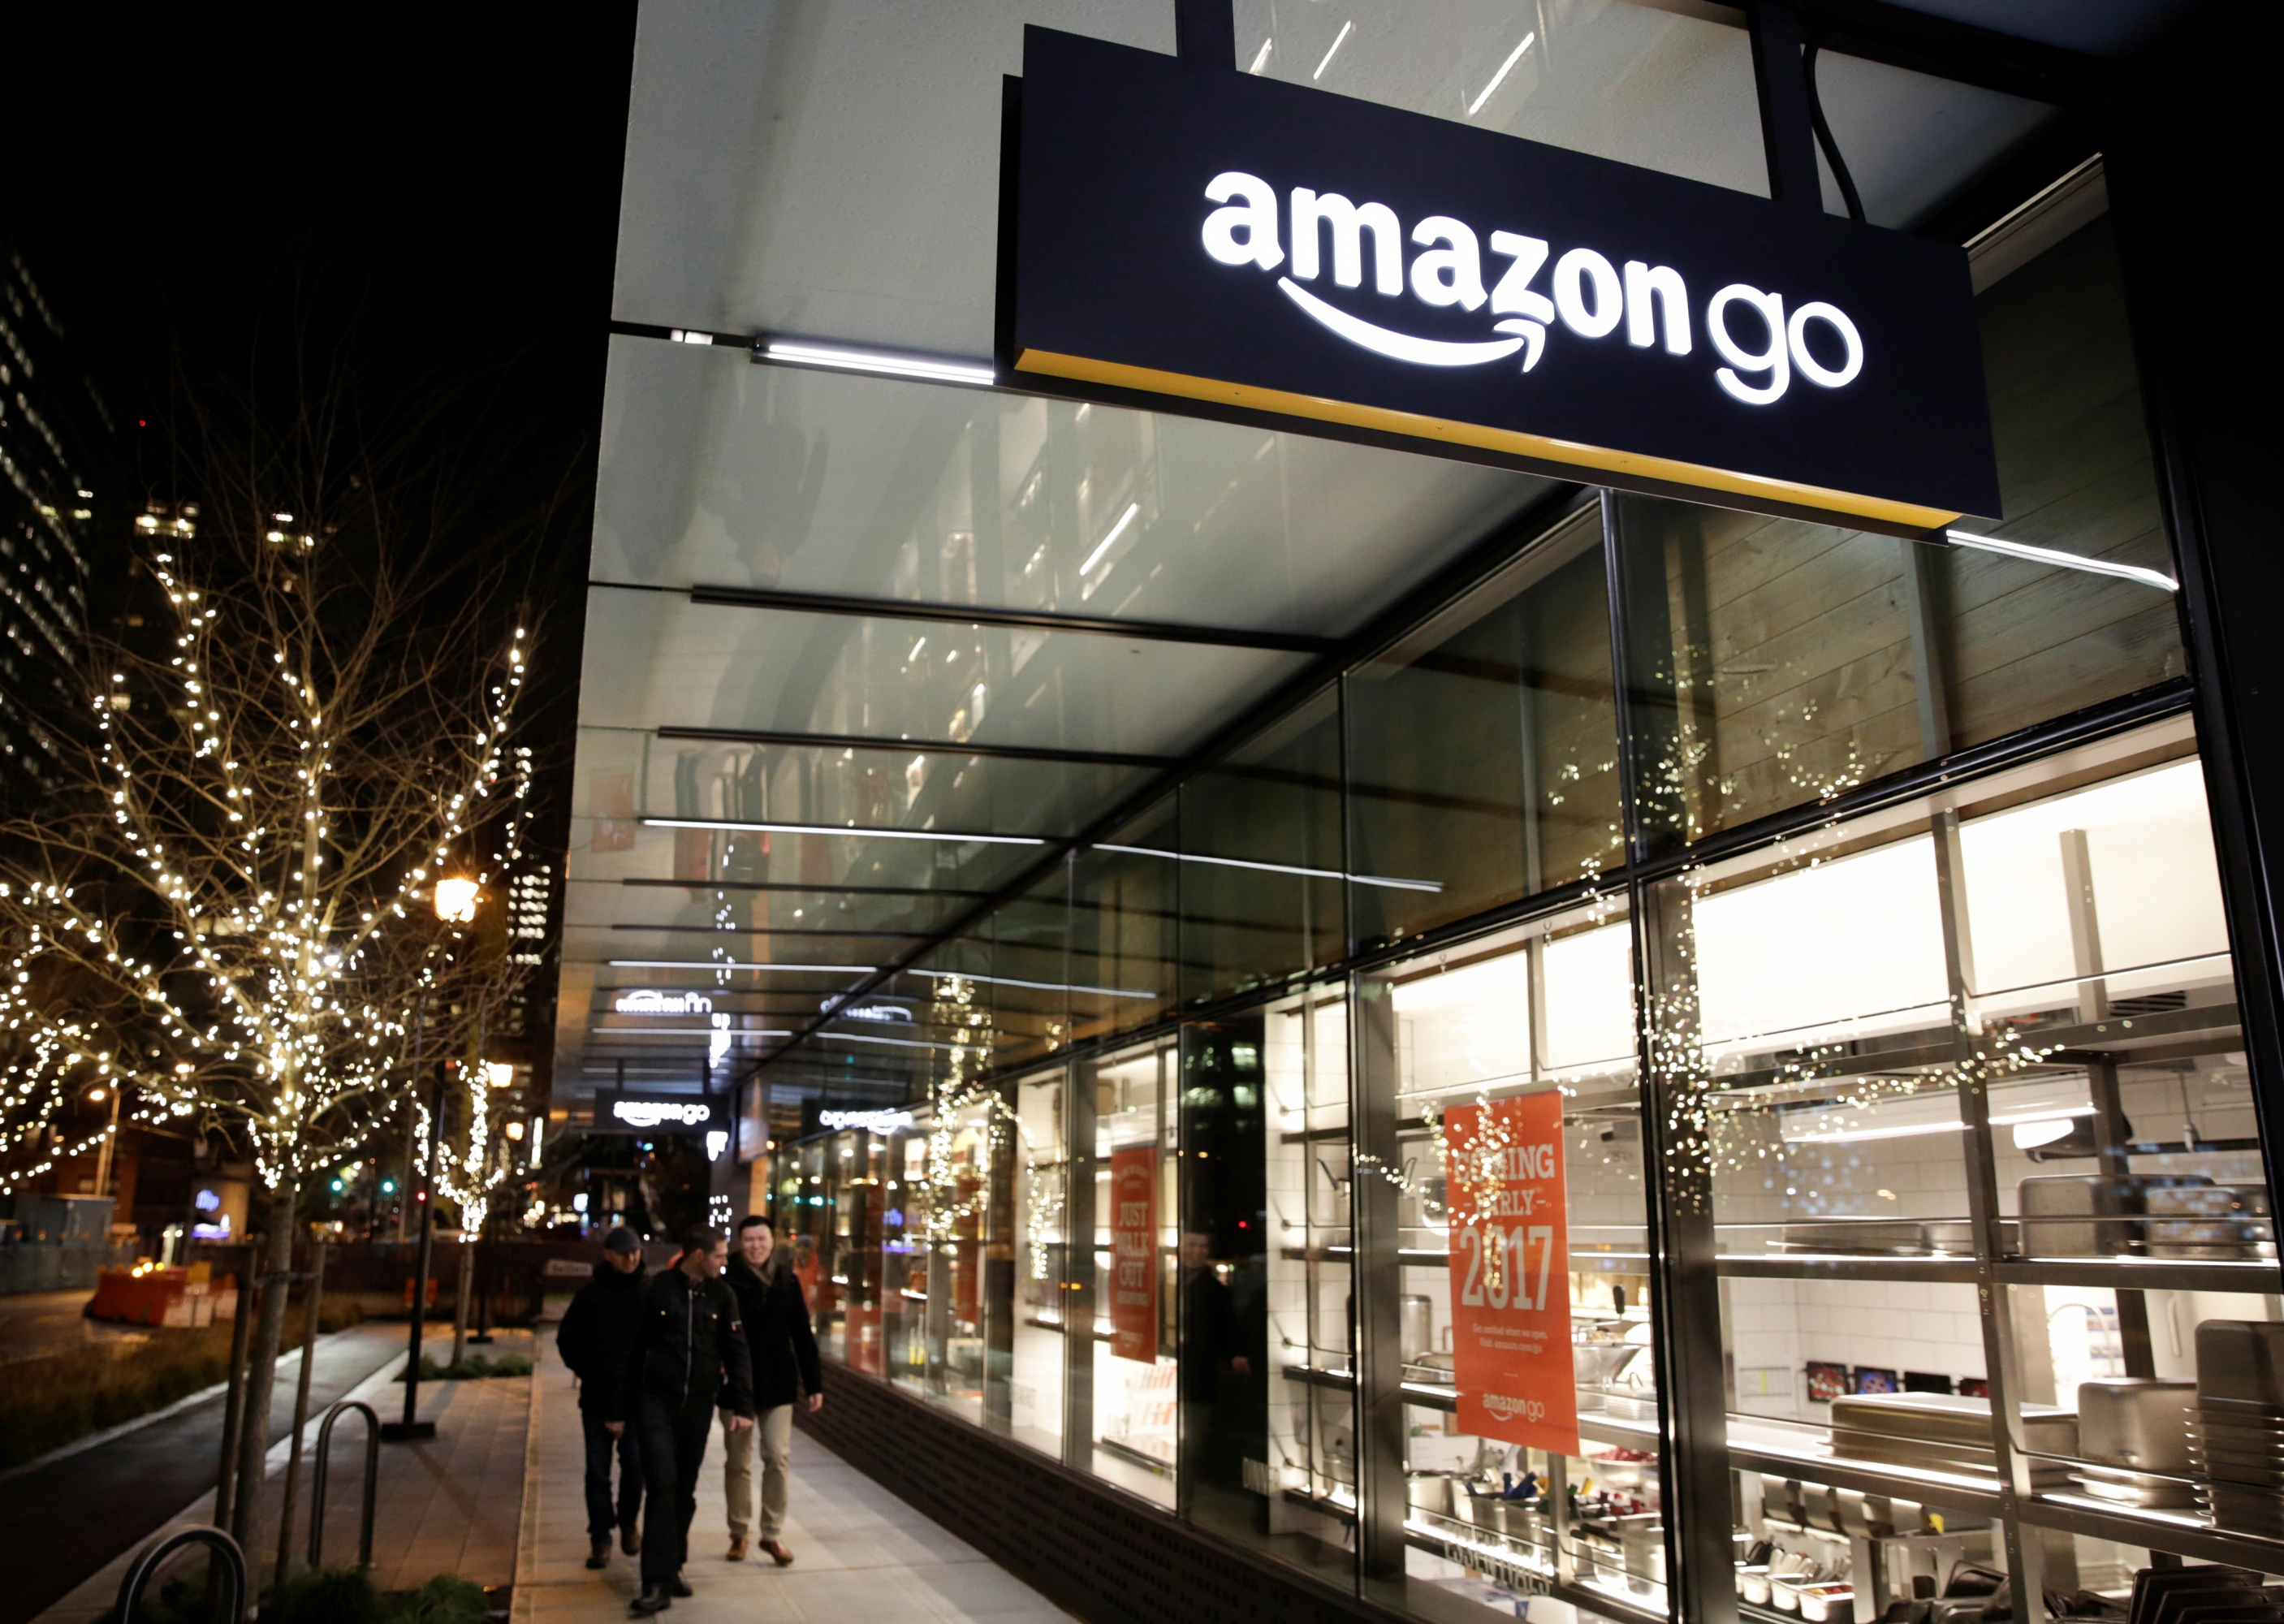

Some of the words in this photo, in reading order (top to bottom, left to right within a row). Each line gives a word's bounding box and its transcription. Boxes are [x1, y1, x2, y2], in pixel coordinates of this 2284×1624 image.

[1202, 171, 1692, 373] amazon
[1707, 283, 1863, 405] go
[682, 1104, 710, 1125] go
[1120, 1202, 1149, 1227] JUST
[1116, 1232, 1151, 1257] WALK
[1120, 1261, 1146, 1288] OUT
[1459, 1224, 1553, 1311] 2017
[1483, 1393, 1526, 1421] amazon
[1526, 1400, 1544, 1423] go
